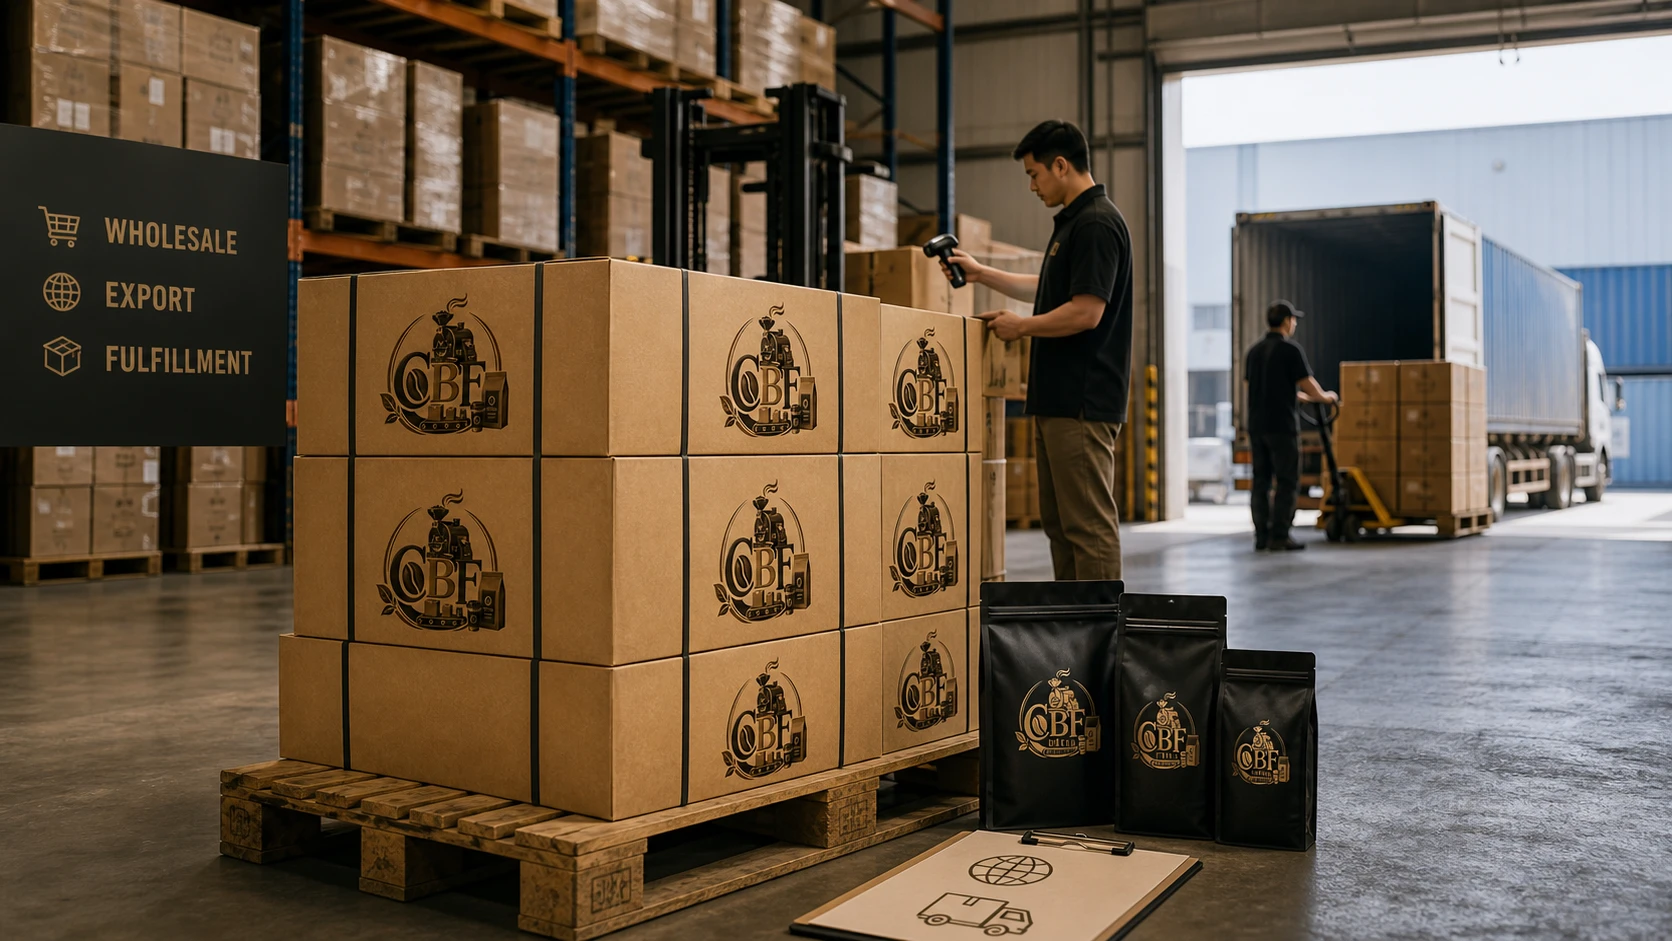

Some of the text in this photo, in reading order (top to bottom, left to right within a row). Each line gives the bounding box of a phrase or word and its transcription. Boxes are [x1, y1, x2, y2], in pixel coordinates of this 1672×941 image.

[104, 217, 237, 255] WHOLESALE
[105, 281, 196, 313] EXPORT
[105, 345, 253, 375] FULFILLMENT
[394, 351, 486, 409] CBF
[731, 354, 801, 412] CBF
[897, 368, 947, 417] CBF
[390, 544, 482, 604] CBF
[725, 537, 794, 597] CBF
[897, 527, 947, 577] CBF
[901, 671, 947, 716] CBF
[731, 709, 792, 760] CBF
[1024, 703, 1085, 741] CBF
[1138, 721, 1187, 753] CBF
[1237, 743, 1279, 771] CBF
